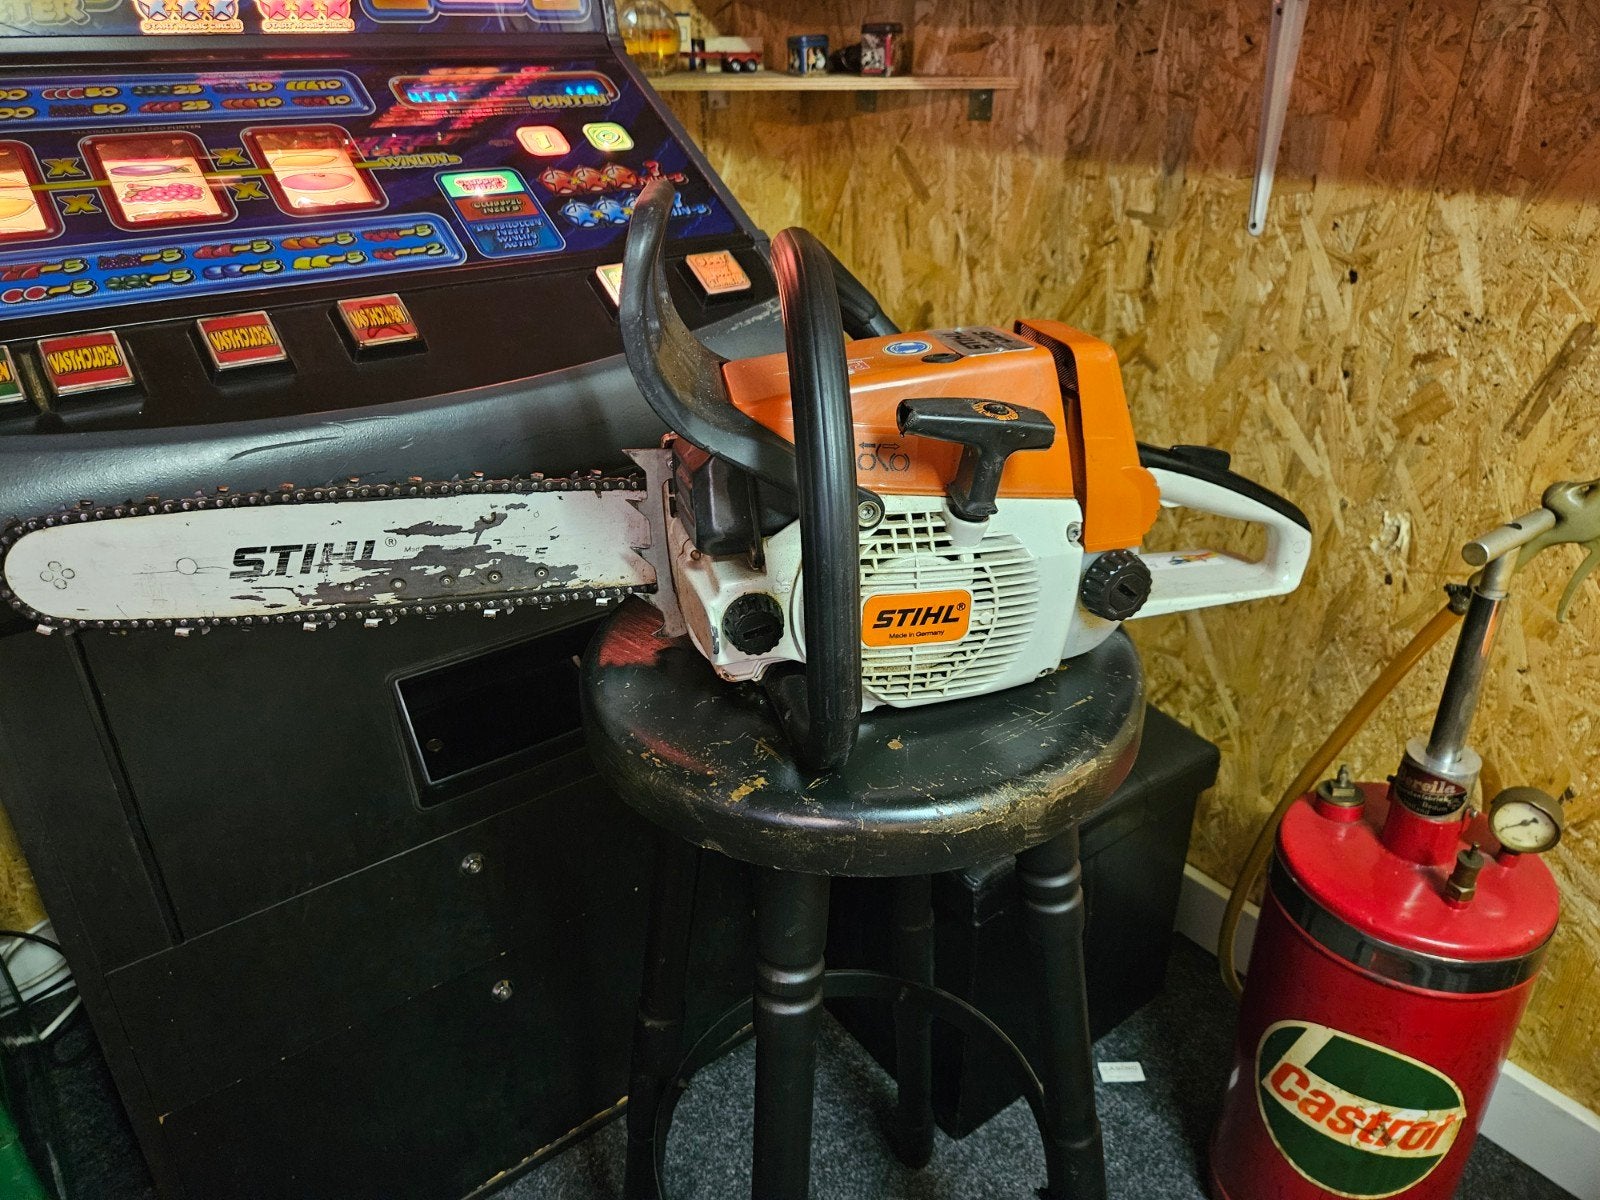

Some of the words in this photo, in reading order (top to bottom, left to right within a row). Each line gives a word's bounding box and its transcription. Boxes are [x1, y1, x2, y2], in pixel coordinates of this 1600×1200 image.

[84, 86, 119, 98] 50
[173, 84, 203, 95] 25
[246, 82, 274, 92] 10
[320, 80, 342, 91] 10
[92, 103, 128, 114] 50
[182, 100, 213, 111] 25
[257, 97, 283, 108] 10
[326, 95, 352, 105] 10
[528, 95, 610, 109] PUNTEN
[63, 259, 87, 273] 5
[161, 248, 184, 263] 5
[251, 240, 272, 253] 5
[336, 233, 356, 245] 5
[415, 225, 433, 237] 5
[72, 280, 96, 295] 5
[171, 269, 194, 283] 5
[262, 260, 282, 273] 5
[346, 251, 365, 264] 5
[426, 244, 444, 255] 2
[209, 325, 276, 352] VASTHOUDEN
[942, 333, 990, 350] STIHL
[48, 344, 120, 374] VASTHOUDEN
[872, 604, 960, 629] STIHL
[916, 629, 945, 638] Germany
[1271, 1062, 1457, 1152] Castrol
